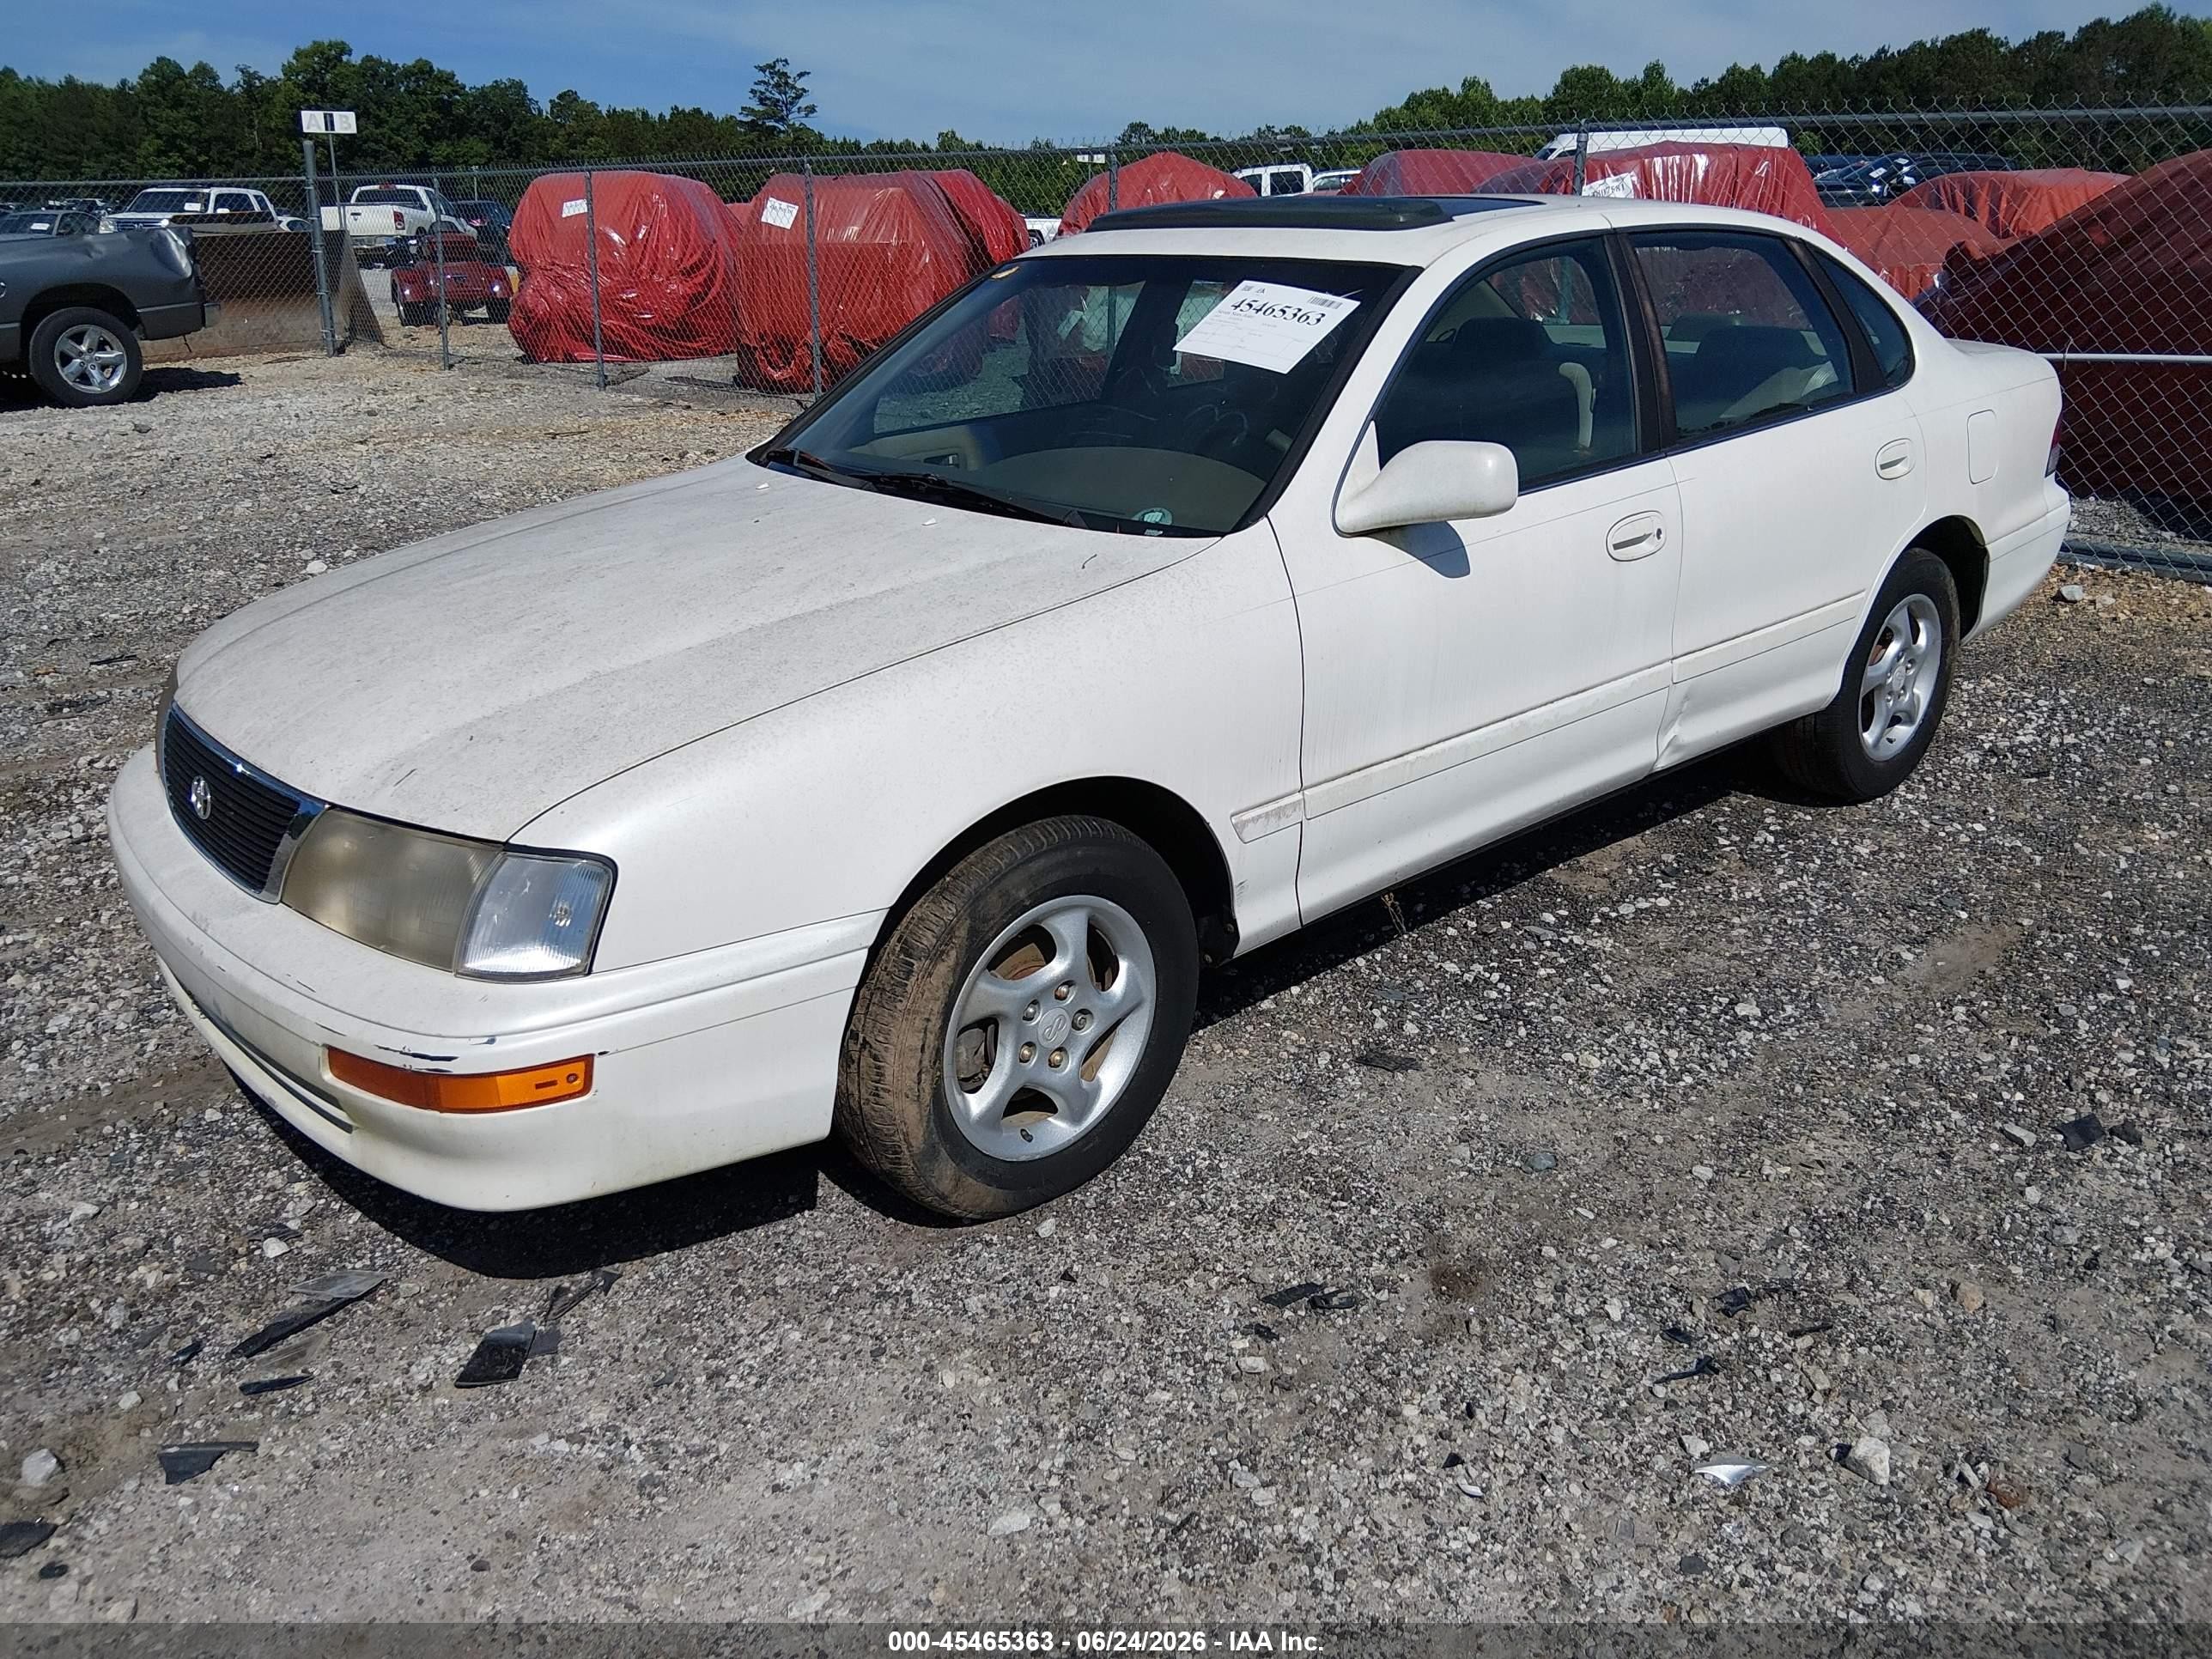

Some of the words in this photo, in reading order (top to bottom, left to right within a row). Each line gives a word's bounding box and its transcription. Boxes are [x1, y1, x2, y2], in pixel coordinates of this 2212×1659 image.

[307, 112, 323, 131] A
[337, 113, 352, 131] B
[1230, 298, 1327, 326] 45465363
